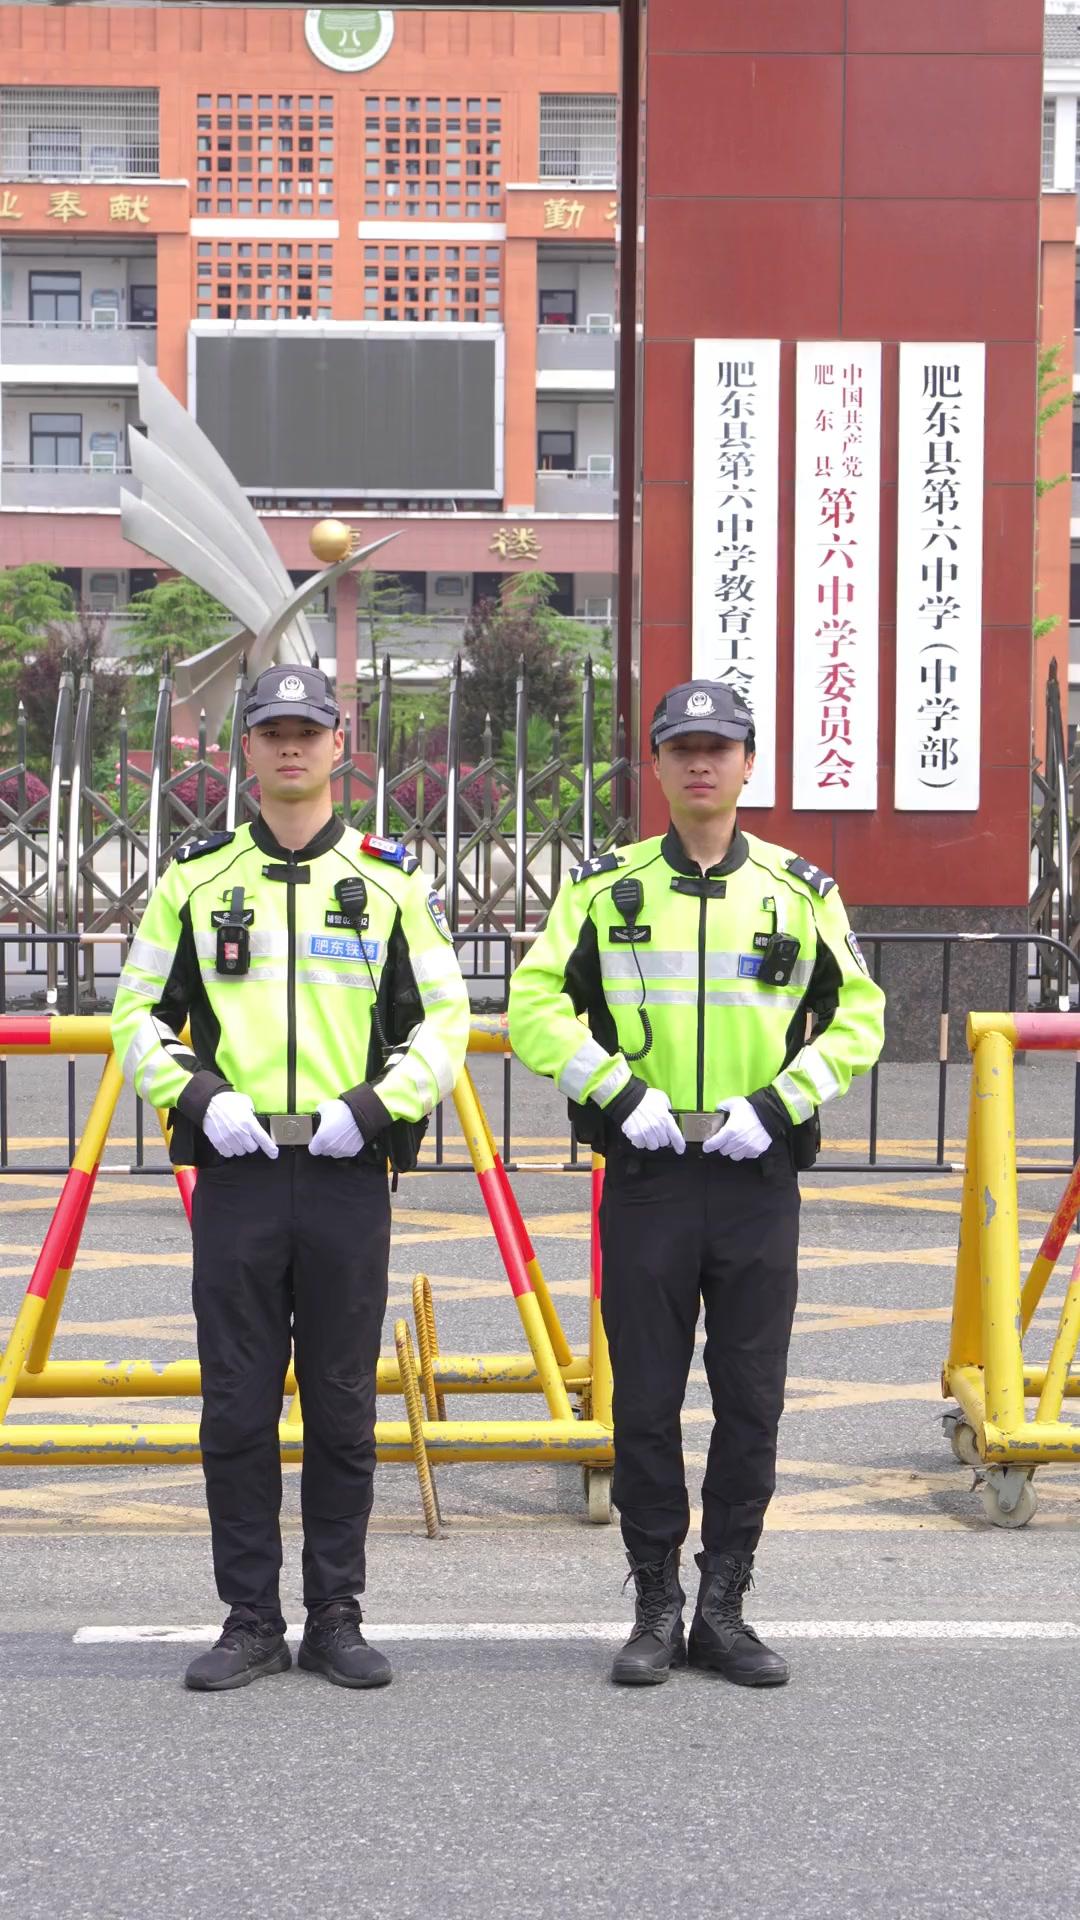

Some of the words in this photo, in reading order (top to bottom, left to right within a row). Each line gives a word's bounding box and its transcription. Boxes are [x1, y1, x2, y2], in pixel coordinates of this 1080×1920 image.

[544, 198, 617, 230] 勤
[813, 364, 835, 477] 肥东县
[842, 363, 863, 478] 中国共产党
[714, 361, 757, 715] 肥东县第六中学教育工会
[814, 487, 858, 788] 第六中学委员会
